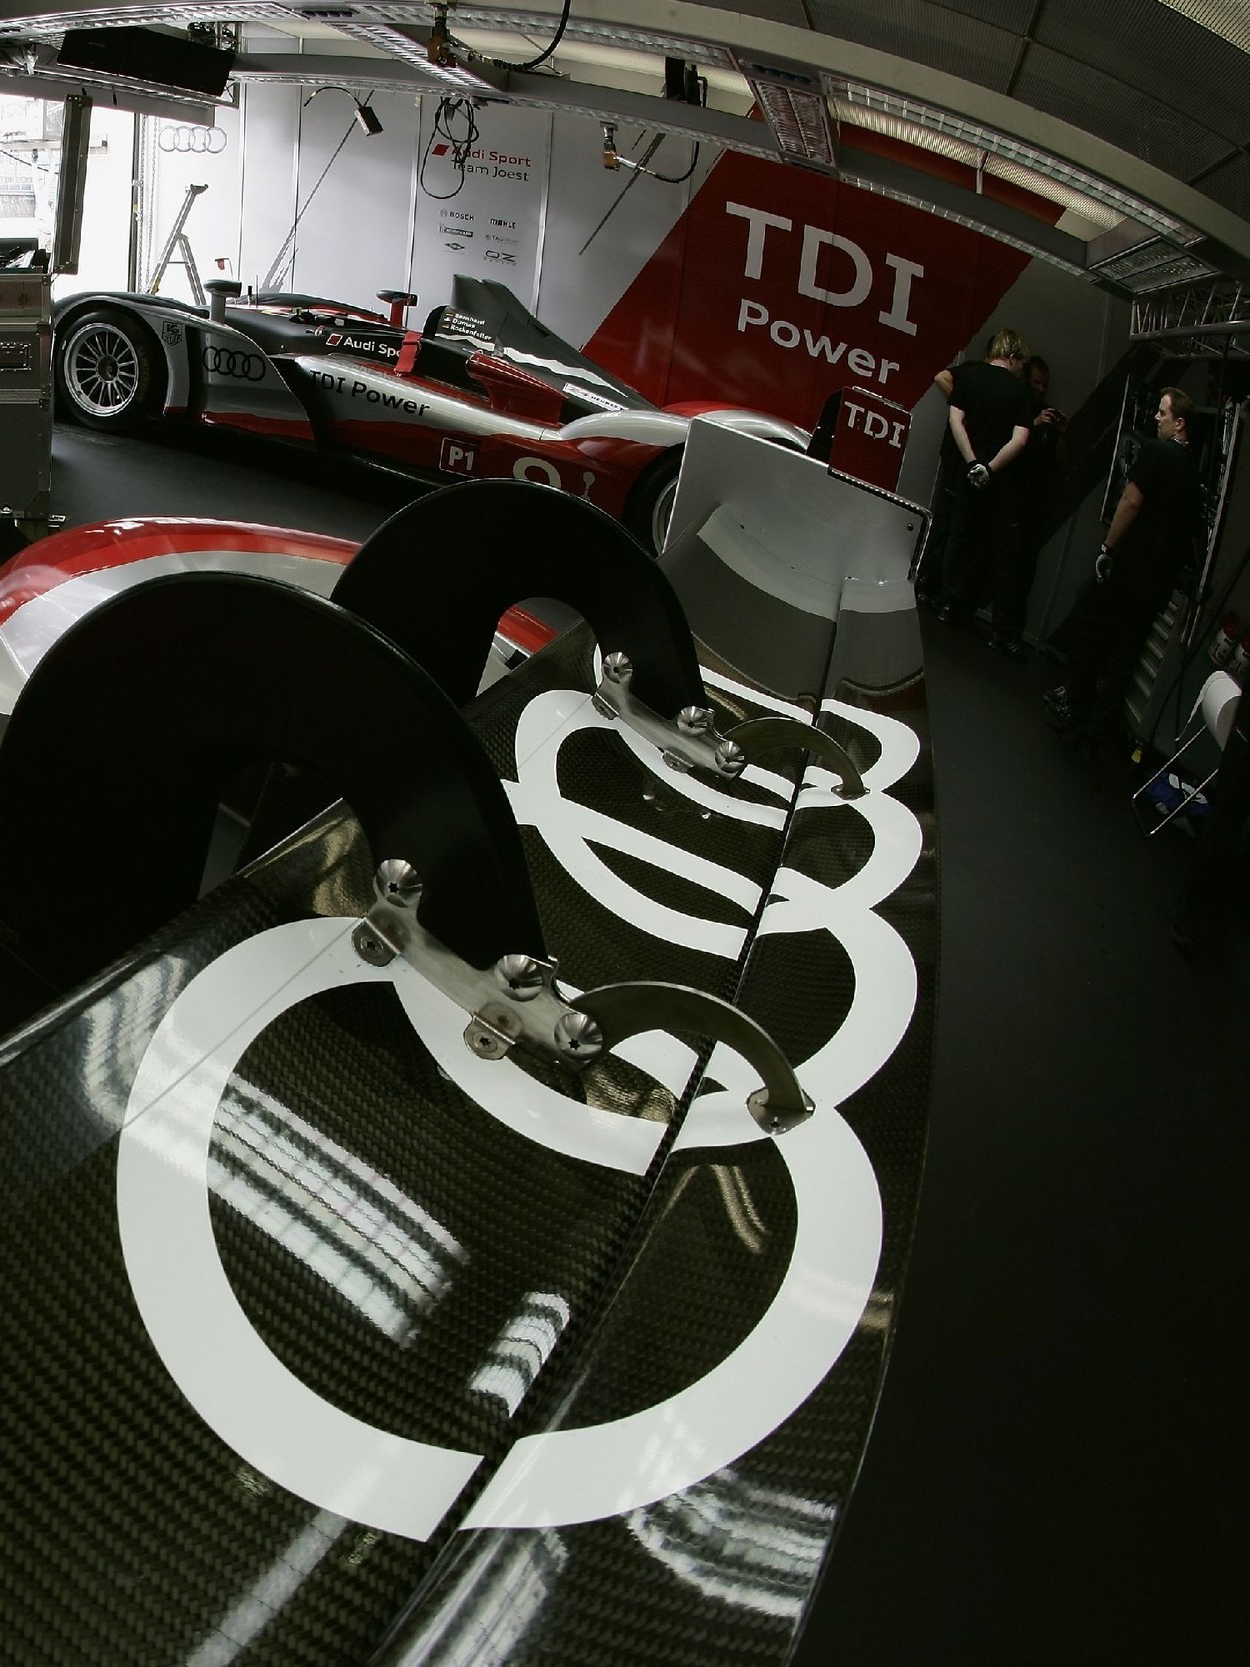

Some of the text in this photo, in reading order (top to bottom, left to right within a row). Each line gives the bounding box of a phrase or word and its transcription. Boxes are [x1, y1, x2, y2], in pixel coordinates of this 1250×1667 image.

[452, 146, 531, 167] Audi Sport
[451, 159, 529, 182] Team Joest
[450, 211, 474, 221] BOSCH
[490, 218, 516, 229] MAHLE
[725, 201, 924, 336] TDI
[343, 337, 401, 358] Audi Spo
[737, 298, 900, 384] Power
[310, 369, 345, 393] TDI
[352, 381, 430, 416] Power
[844, 401, 906, 448] TDI
[449, 446, 474, 471] P1
